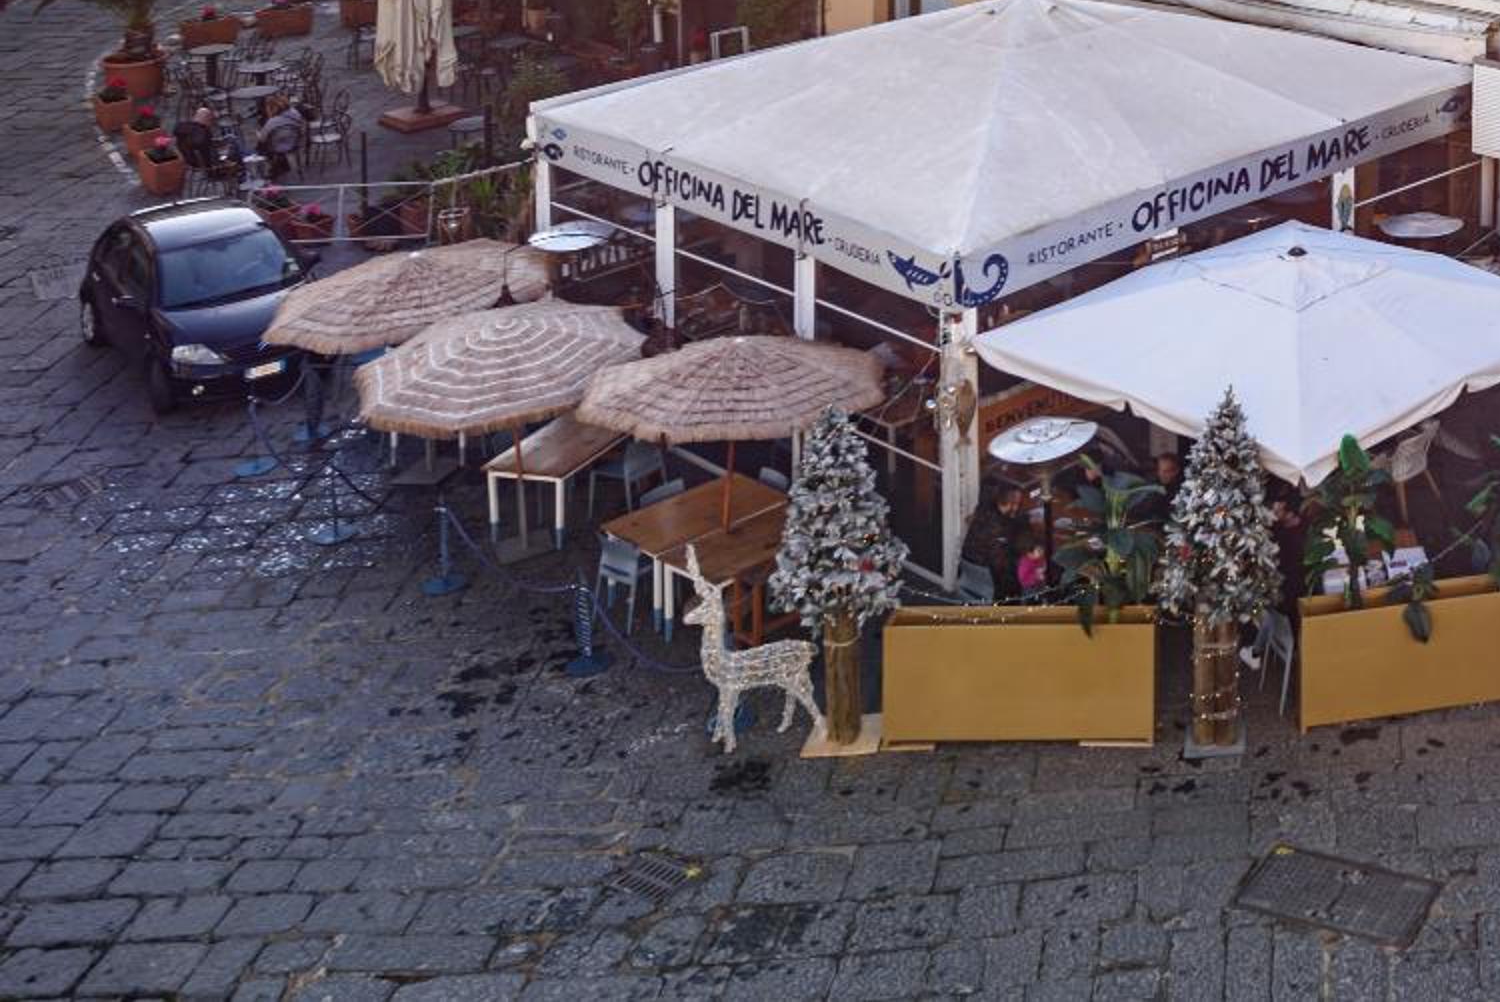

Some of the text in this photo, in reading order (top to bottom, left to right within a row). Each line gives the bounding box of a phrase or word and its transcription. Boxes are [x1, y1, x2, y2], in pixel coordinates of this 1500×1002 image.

[573, 145, 631, 176] RISTORANTE
[638, 160, 725, 212] OFFICINA
[732, 189, 764, 230] DEL
[770, 200, 825, 246] MARE
[1028, 221, 1114, 265] RISTORANTE
[1131, 167, 1250, 233] OFFICINA
[1260, 150, 1299, 192] DEL
[1307, 125, 1372, 172] MARE
[1381, 115, 1431, 140] CRUDERIA
